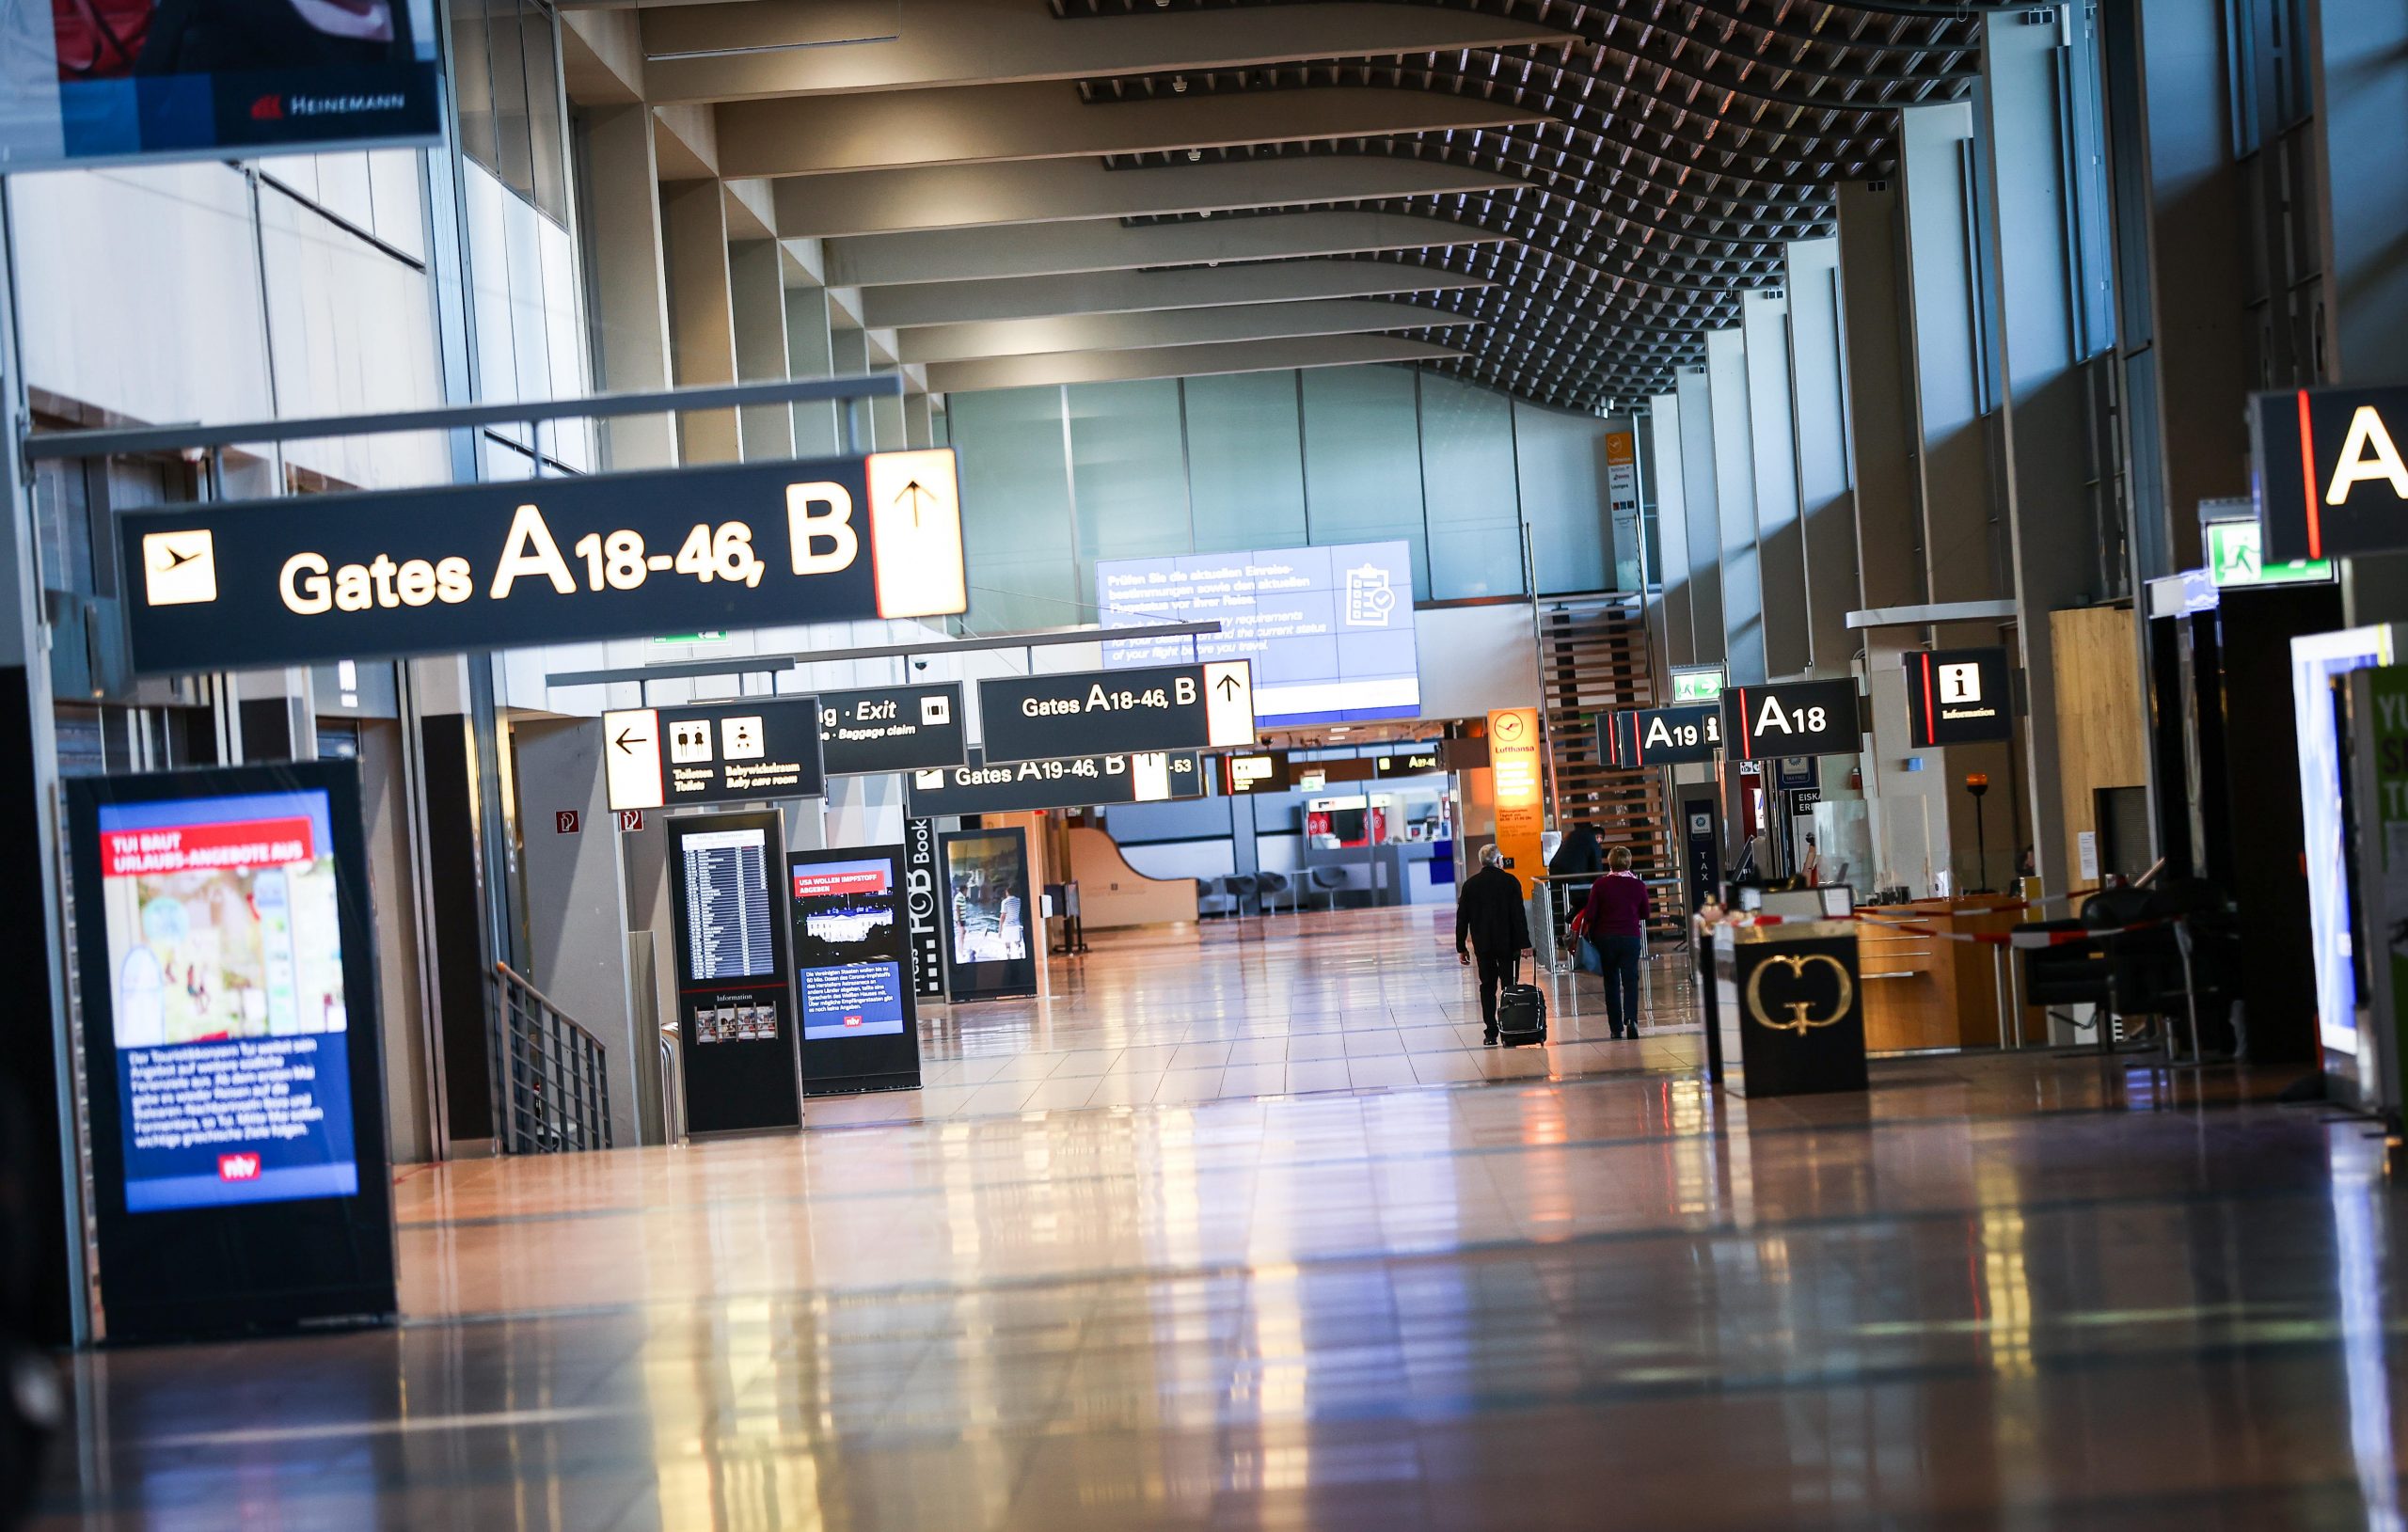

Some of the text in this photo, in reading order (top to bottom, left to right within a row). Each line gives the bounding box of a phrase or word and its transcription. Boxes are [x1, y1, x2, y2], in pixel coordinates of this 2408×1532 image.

[291, 92, 405, 116] HEINEMANN
[2325, 405, 2408, 506] A
[279, 482, 858, 616] Gates A18-46, B
[1022, 676, 1196, 718] Gates A18-46, B
[856, 700, 897, 721] Exit
[1753, 695, 1827, 737] A18
[838, 728, 885, 741] Baggage
[886, 723, 916, 735] claim
[1644, 717, 1697, 750] A19
[673, 767, 714, 781] Toiletten
[726, 775, 798, 790] Baby care room
[955, 766, 1012, 787] Gates
[674, 780, 705, 792] Toilets
[223, 1156, 257, 1178] ntv
